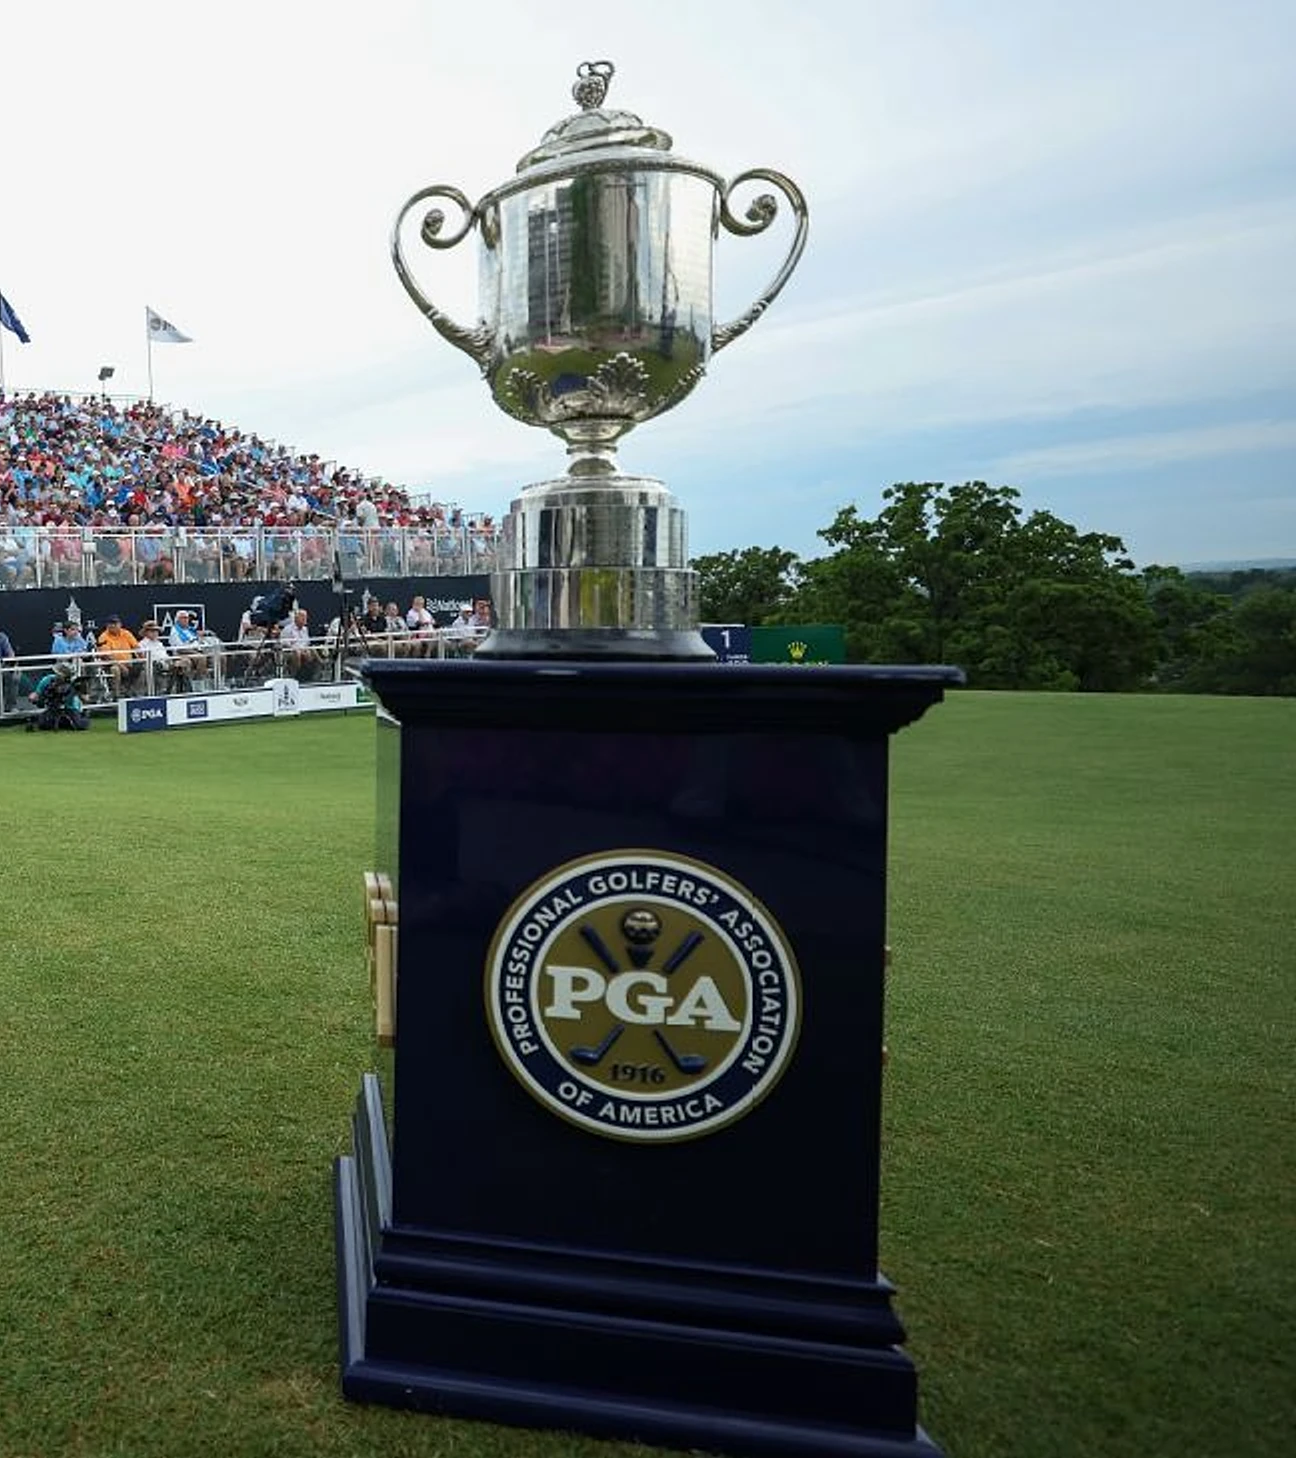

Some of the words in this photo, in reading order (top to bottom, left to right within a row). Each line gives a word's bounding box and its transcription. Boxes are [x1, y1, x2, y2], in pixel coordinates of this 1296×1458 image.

[161, 610, 198, 631] AG
[720, 630, 731, 649] 1
[505, 888, 583, 1055] PROFESSIONAL
[719, 908, 782, 1074] ASSOCIATION
[544, 965, 742, 1031] PGA
[610, 1064, 666, 1085] 1916
[557, 1081, 594, 1107] OF
[599, 1093, 723, 1125] AMERICA
